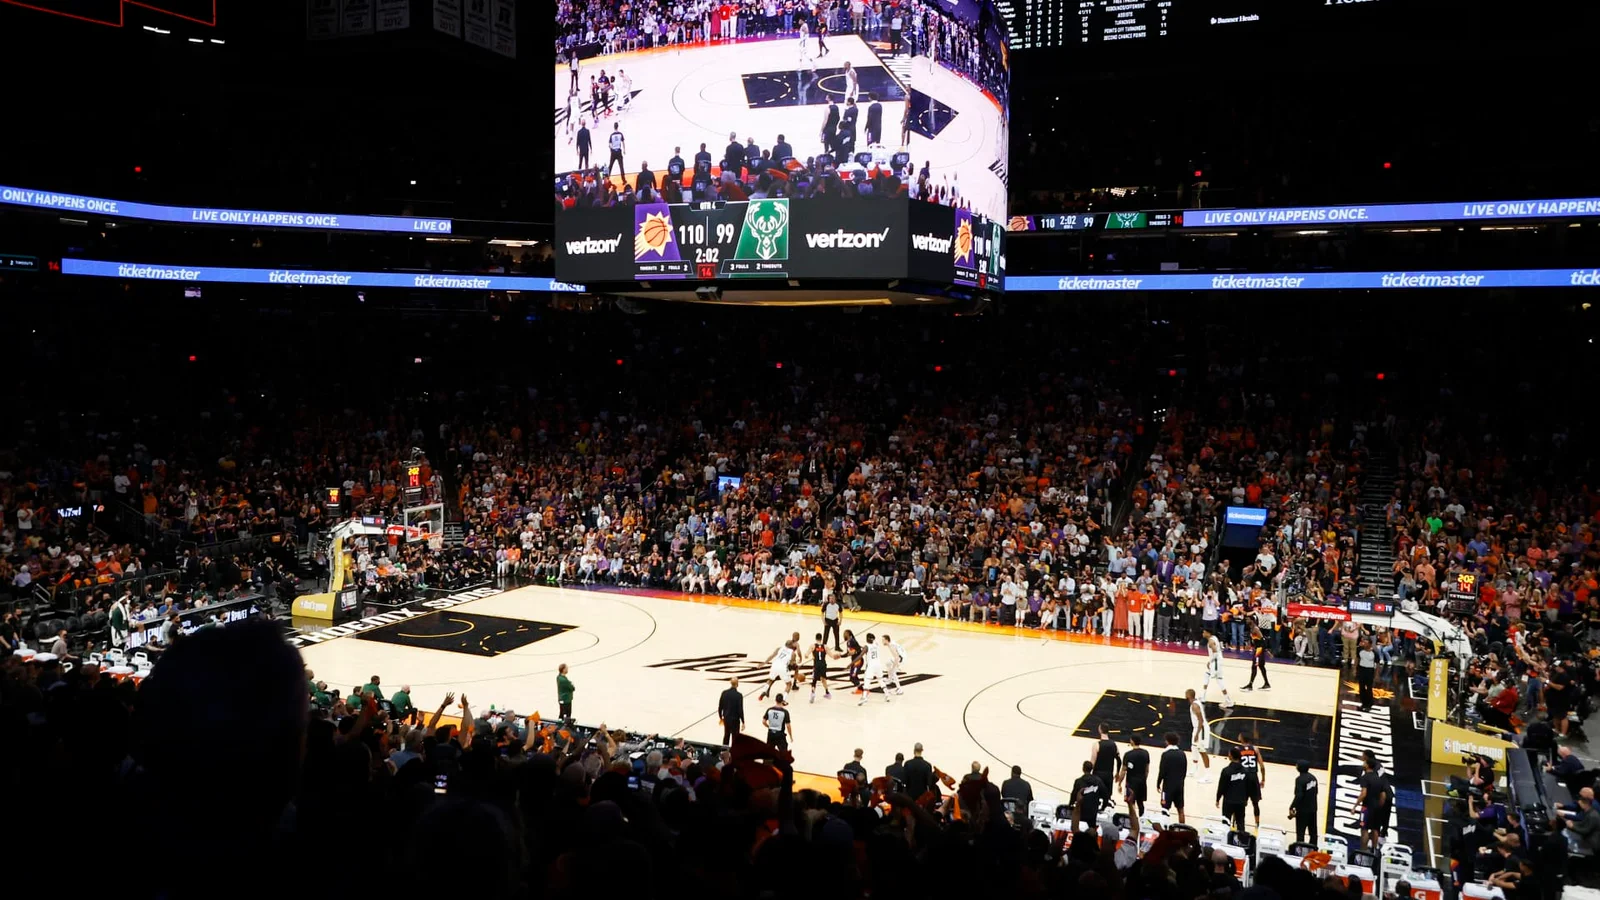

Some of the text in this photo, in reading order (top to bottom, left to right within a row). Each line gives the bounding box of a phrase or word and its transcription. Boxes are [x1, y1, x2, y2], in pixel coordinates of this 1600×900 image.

[3, 189, 119, 213] ONLY HAPPENS ONCE.
[1205, 208, 1369, 223] LIVE ONLY HAPPENS ONCE.
[1463, 204, 1495, 216] LIVE
[1497, 203, 1536, 215] ONLY
[192, 210, 340, 227] LIVE ONLY HAPPENS ONCE.
[414, 220, 437, 231] LIVE
[1041, 218, 1055, 228] 110
[1060, 215, 1077, 225] 2:02
[1083, 217, 1094, 227] 99
[1174, 216, 1182, 224] 14
[679, 224, 704, 245] 110
[716, 224, 735, 244] 99
[805, 229, 881, 248] verizon
[566, 237, 616, 255] verizon
[912, 232, 949, 254] verizon
[695, 248, 719, 263] 2:02
[47, 261, 59, 271] 14
[118, 264, 200, 281] ticketmaster
[702, 267, 712, 277] 14
[269, 269, 351, 285] ticketmaster
[414, 275, 491, 289] ticketmaster
[1058, 276, 1142, 290] ticketmaster
[1212, 275, 1304, 289] ticketmaster
[1381, 273, 1484, 287] ticketmaster
[409, 476, 418, 486] 14
[1460, 582, 1470, 592] 14
[421, 587, 504, 609] SUNS
[1328, 612, 1346, 620] Farm
[818, 651, 821, 660] 1
[871, 650, 878, 659] 21
[1434, 661, 1443, 698] NBA TV
[1452, 740, 1477, 755] that's
[1240, 755, 1256, 768] 25
